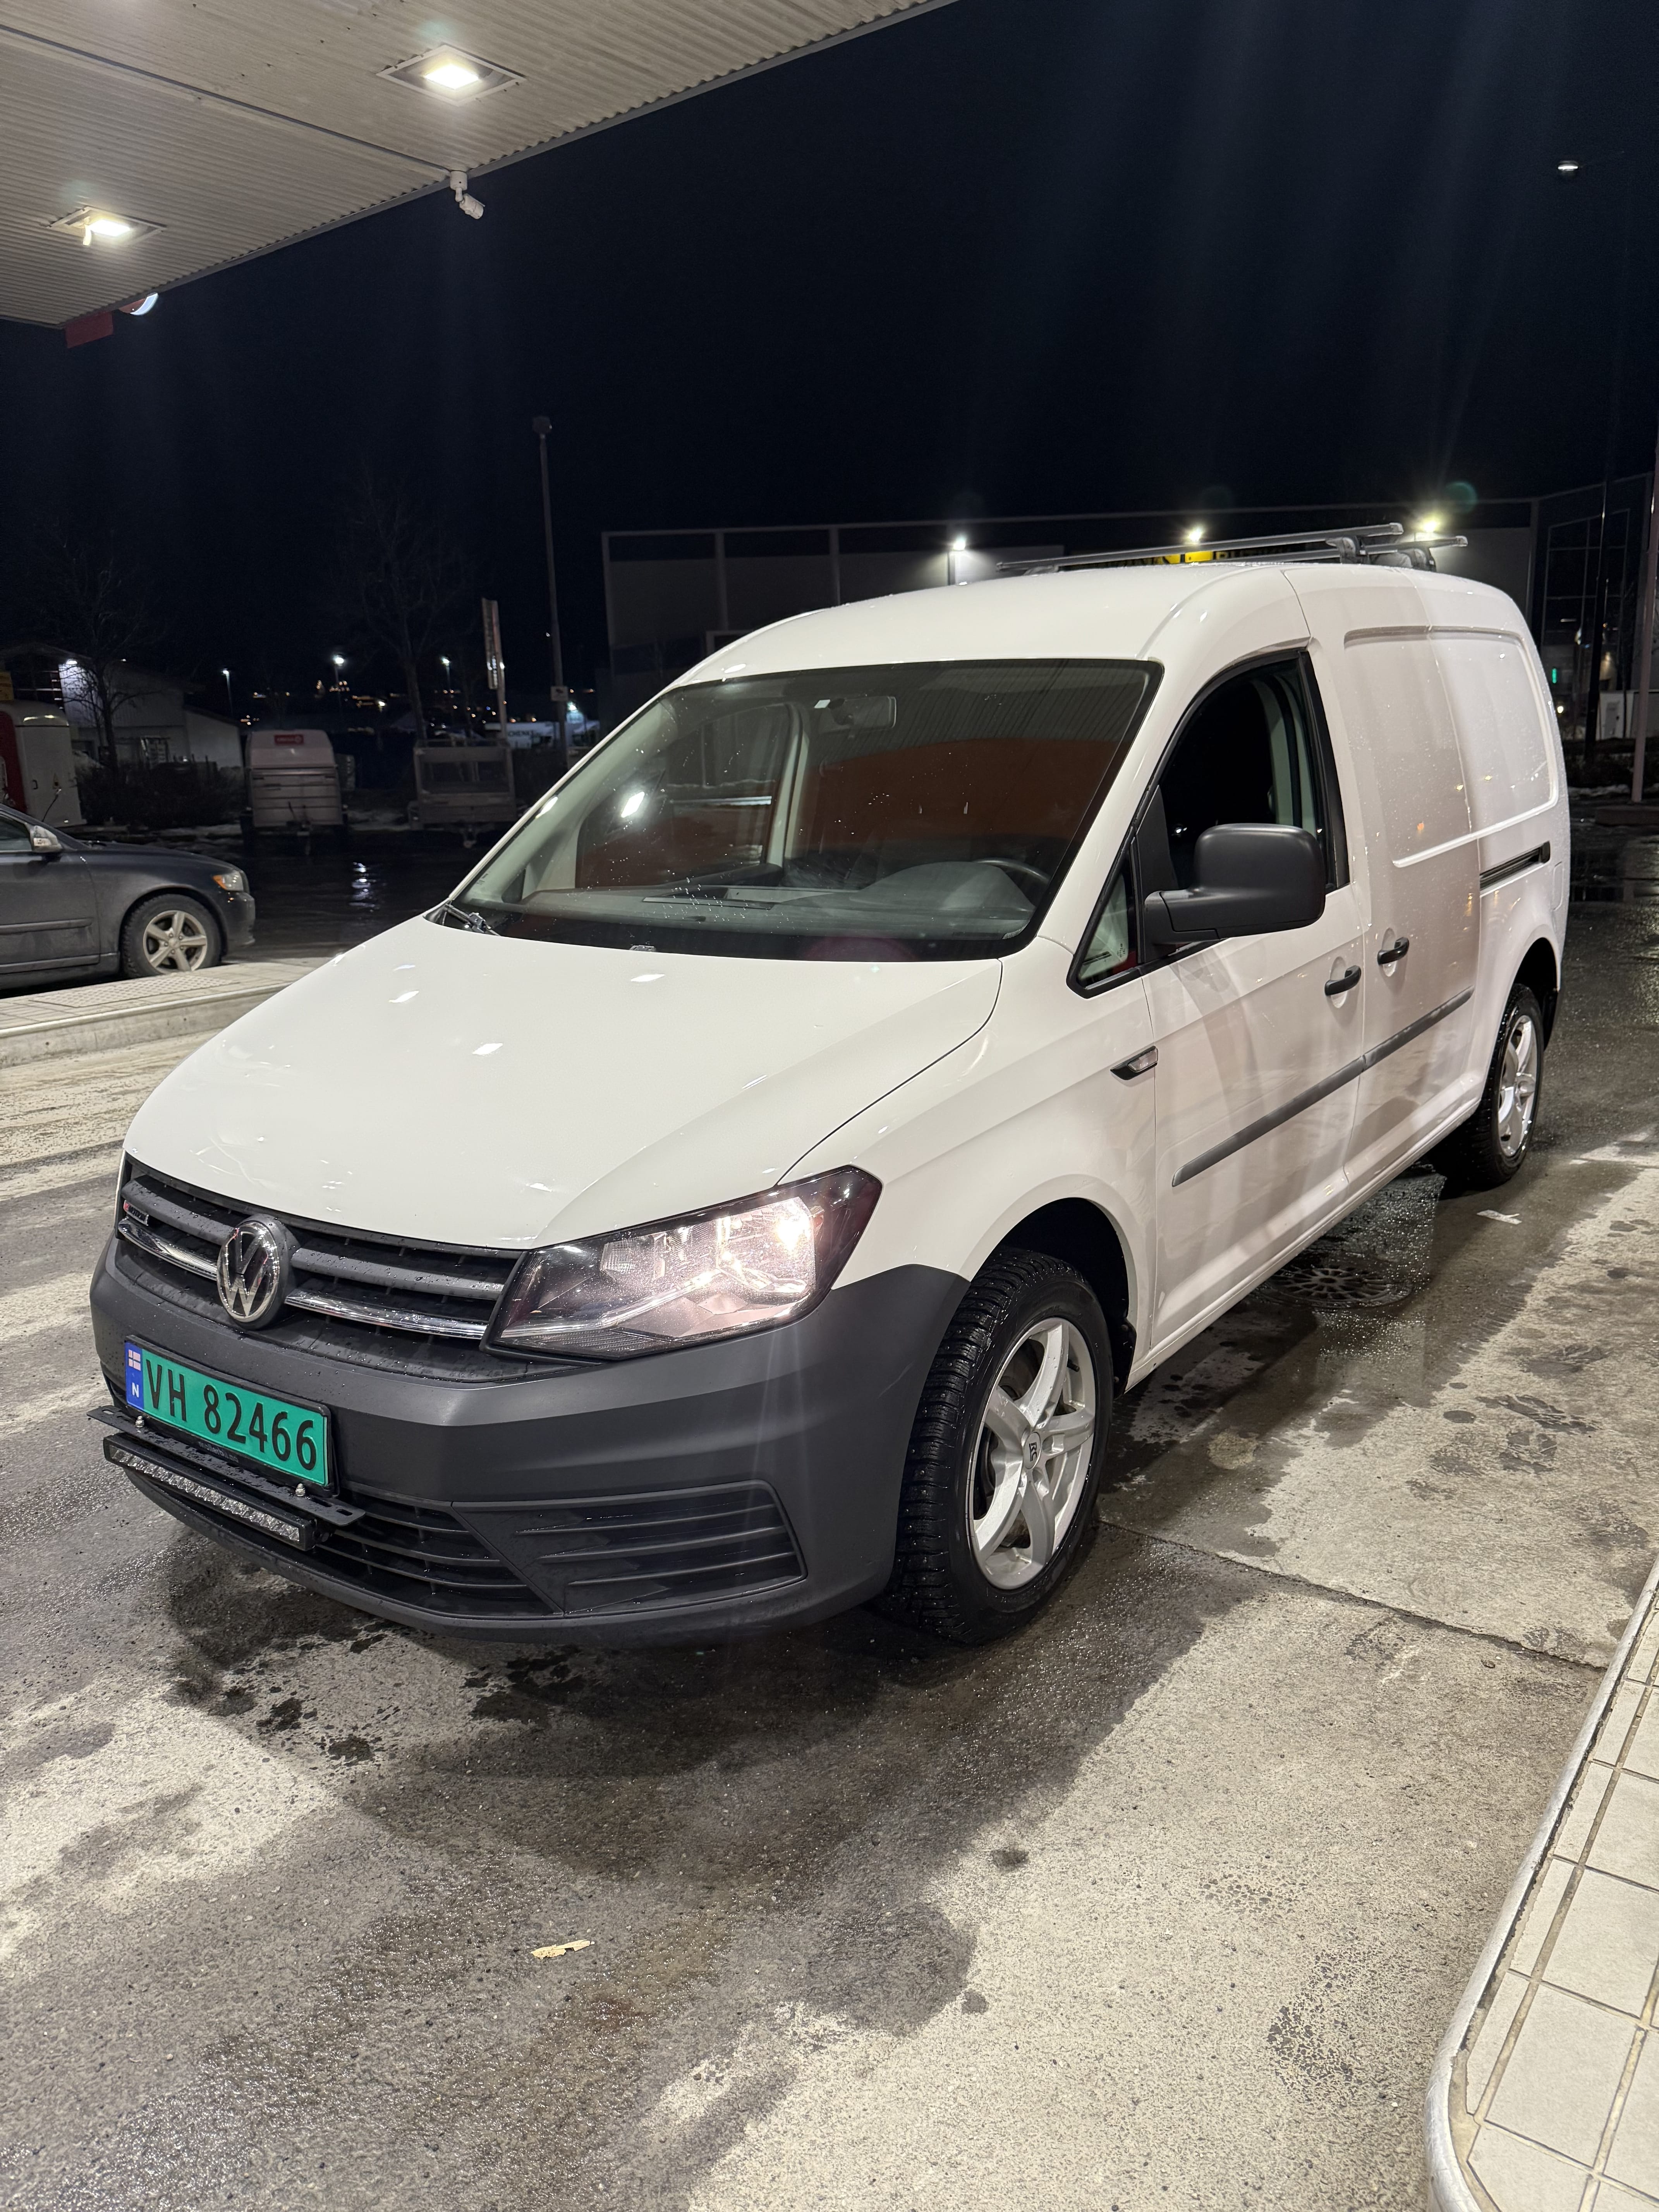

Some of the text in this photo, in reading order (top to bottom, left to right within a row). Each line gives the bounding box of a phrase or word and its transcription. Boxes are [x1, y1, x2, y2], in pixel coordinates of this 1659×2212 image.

[132, 1382, 139, 1398] N
[146, 1358, 317, 1471] VH 82466
